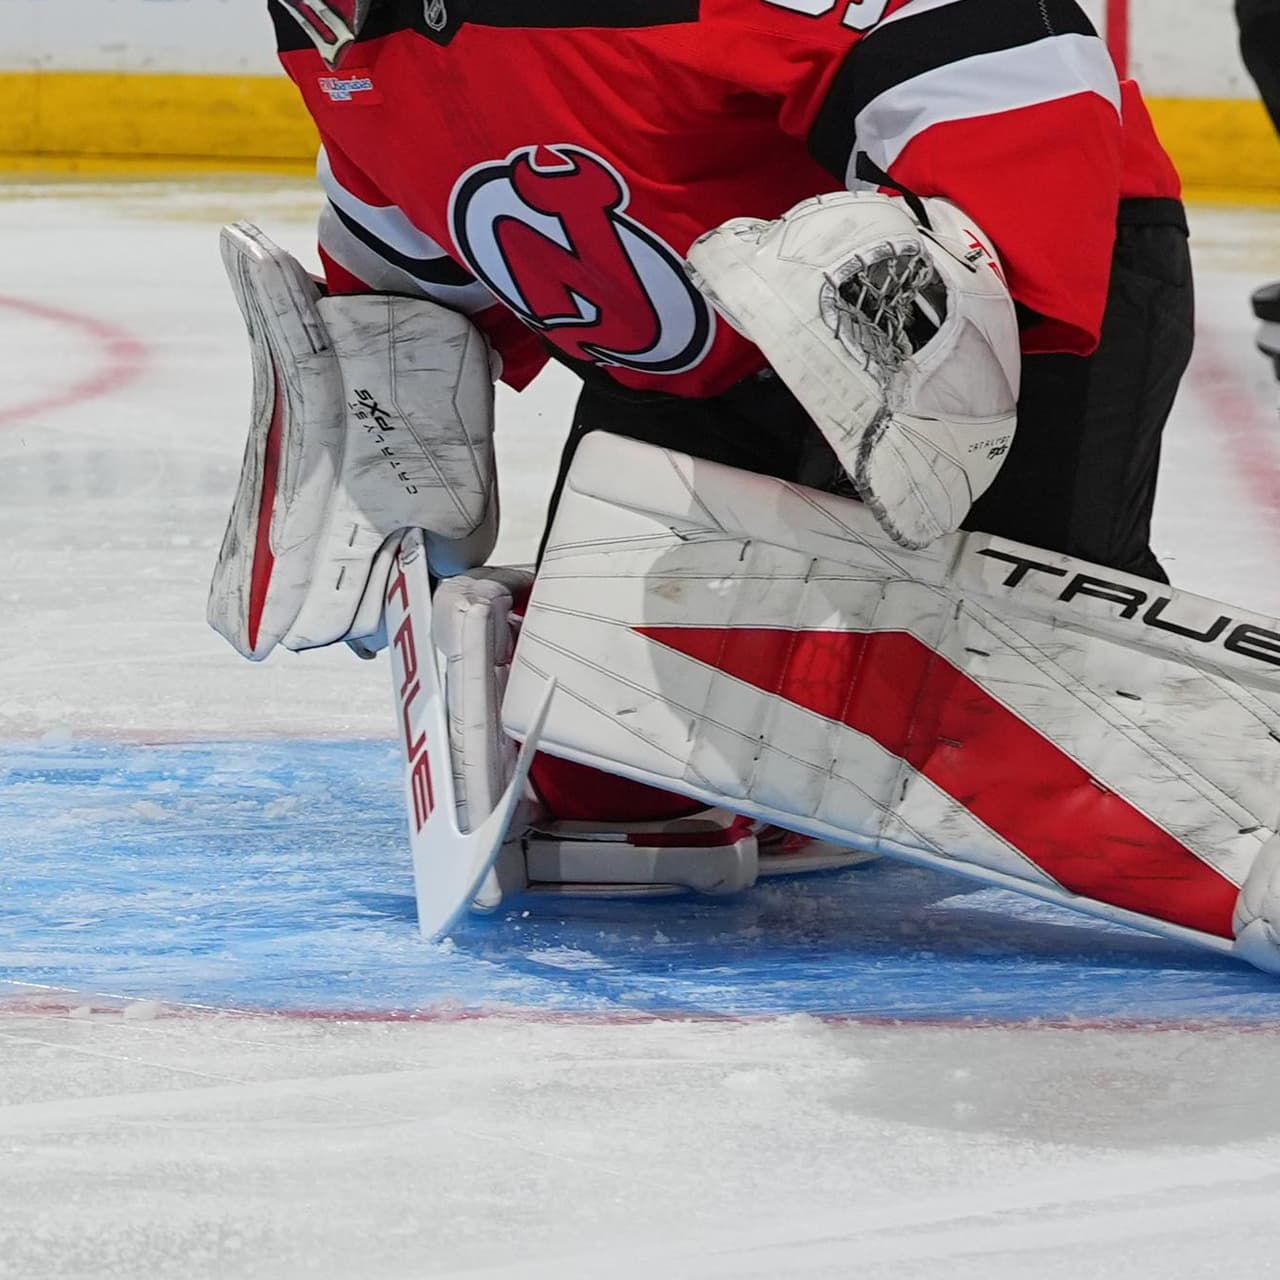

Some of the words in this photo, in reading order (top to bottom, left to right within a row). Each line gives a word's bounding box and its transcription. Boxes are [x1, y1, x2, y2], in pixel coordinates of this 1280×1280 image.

[347, 402, 419, 495] CATALYST
[975, 547, 1280, 668] TRUE
[387, 542, 436, 835] TRUE
